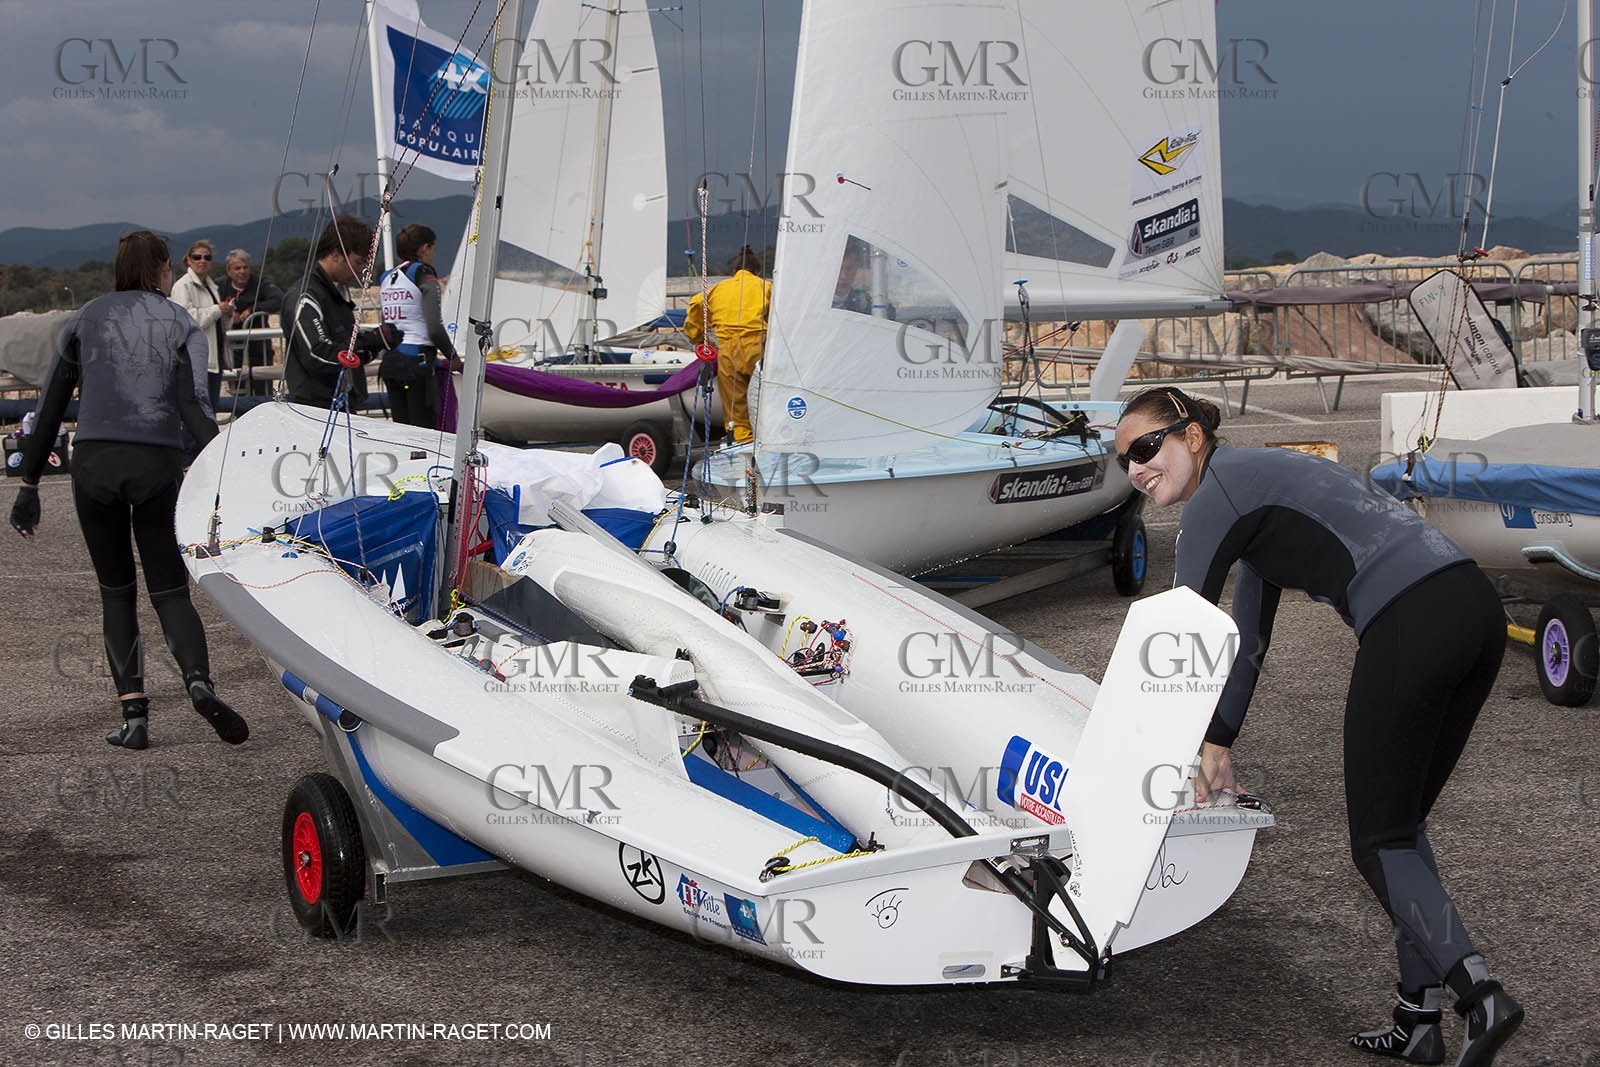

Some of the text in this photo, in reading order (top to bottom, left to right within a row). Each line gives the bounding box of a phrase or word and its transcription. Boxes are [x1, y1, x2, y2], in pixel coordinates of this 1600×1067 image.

[399, 113, 474, 143] BANQU
[400, 130, 481, 159] POPULAIR
[382, 290, 414, 301] TOYOTA
[384, 306, 407, 320] BUL
